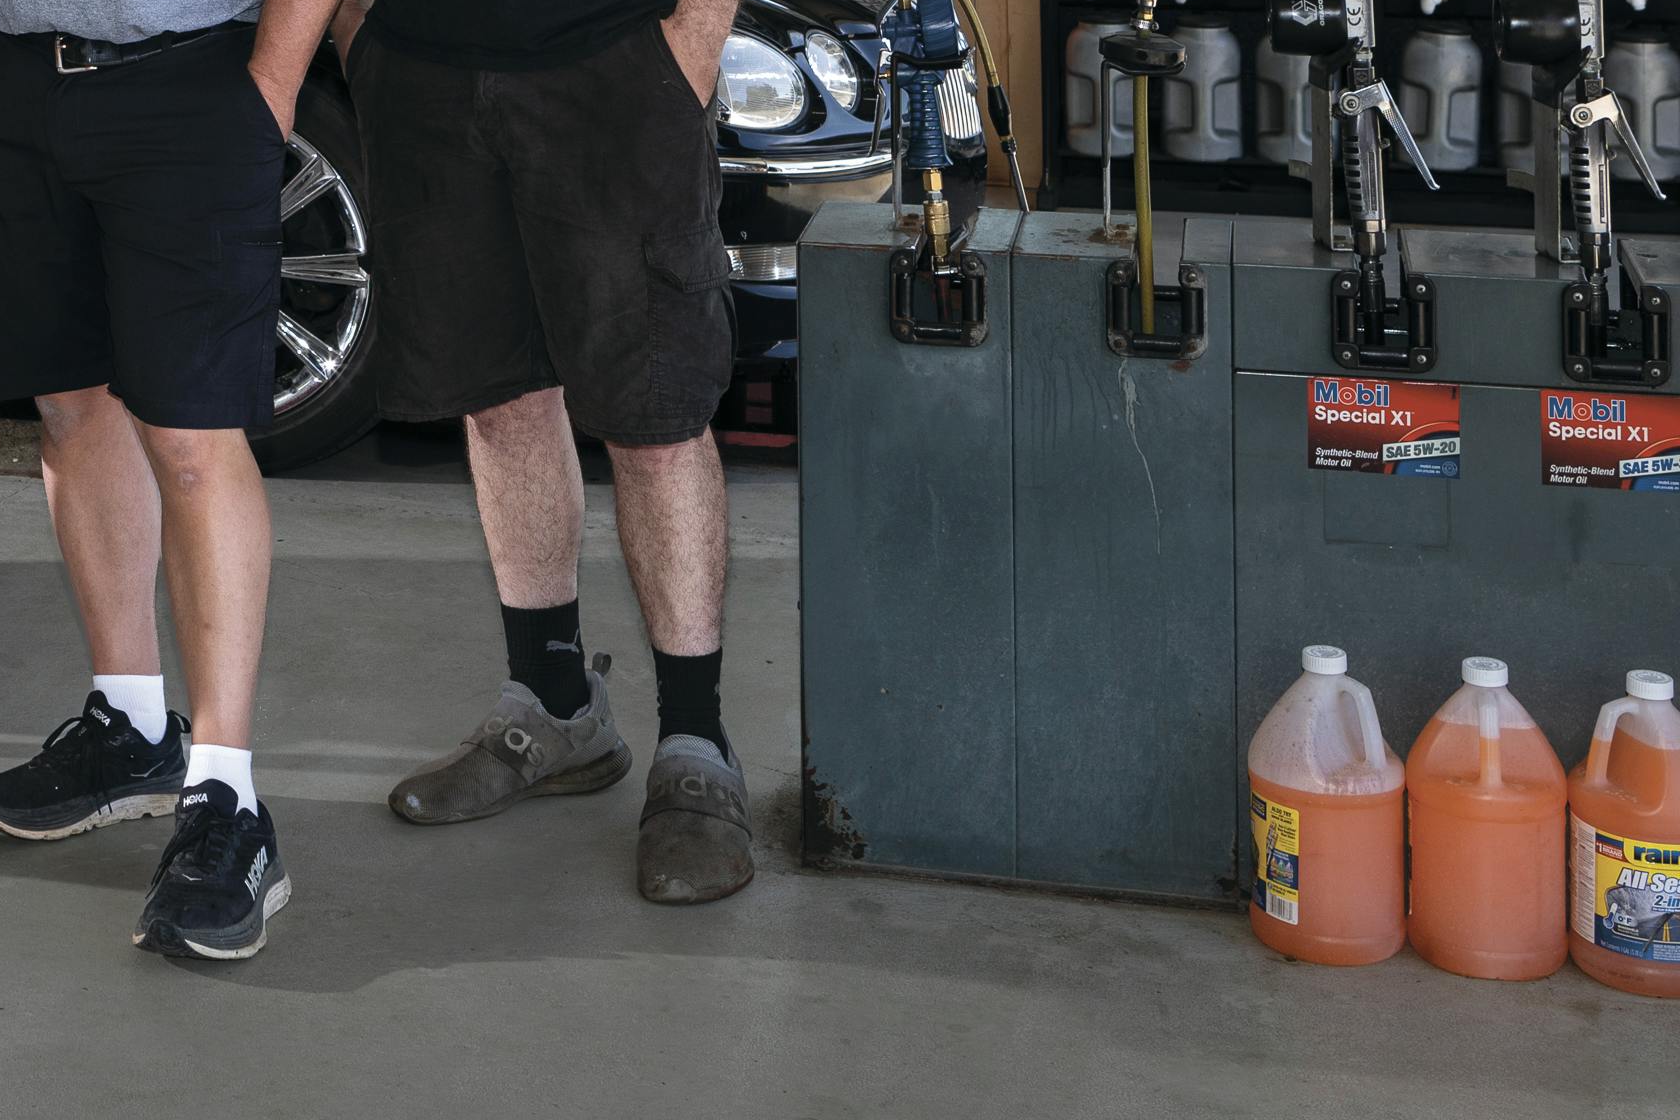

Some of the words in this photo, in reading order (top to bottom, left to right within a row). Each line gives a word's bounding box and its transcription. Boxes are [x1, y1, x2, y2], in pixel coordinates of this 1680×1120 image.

[1314, 380, 1390, 407] Mobil
[1314, 405, 1386, 424] Special
[1390, 410, 1412, 426] X1
[1547, 395, 1626, 423] Mobil
[1548, 421, 1622, 440] Special
[1627, 426, 1649, 442] X1
[1315, 447, 1379, 459] Synthetic-Blend
[1385, 444, 1412, 459] SAE
[1413, 441, 1456, 456] 5W-20
[1315, 457, 1339, 467] Motor
[1340, 457, 1352, 467] Oil
[1549, 464, 1615, 476] Synthetic-Blend
[1622, 460, 1649, 475] SAE
[1651, 457, 1680, 472] 5W-
[1549, 474, 1574, 484] Motor
[1575, 475, 1587, 485] Oil
[89, 706, 111, 727] HOKA
[182, 792, 209, 808] HOKA
[243, 845, 269, 901] HOKA
[1617, 866, 1649, 890] All
[1651, 873, 1680, 894] Se
